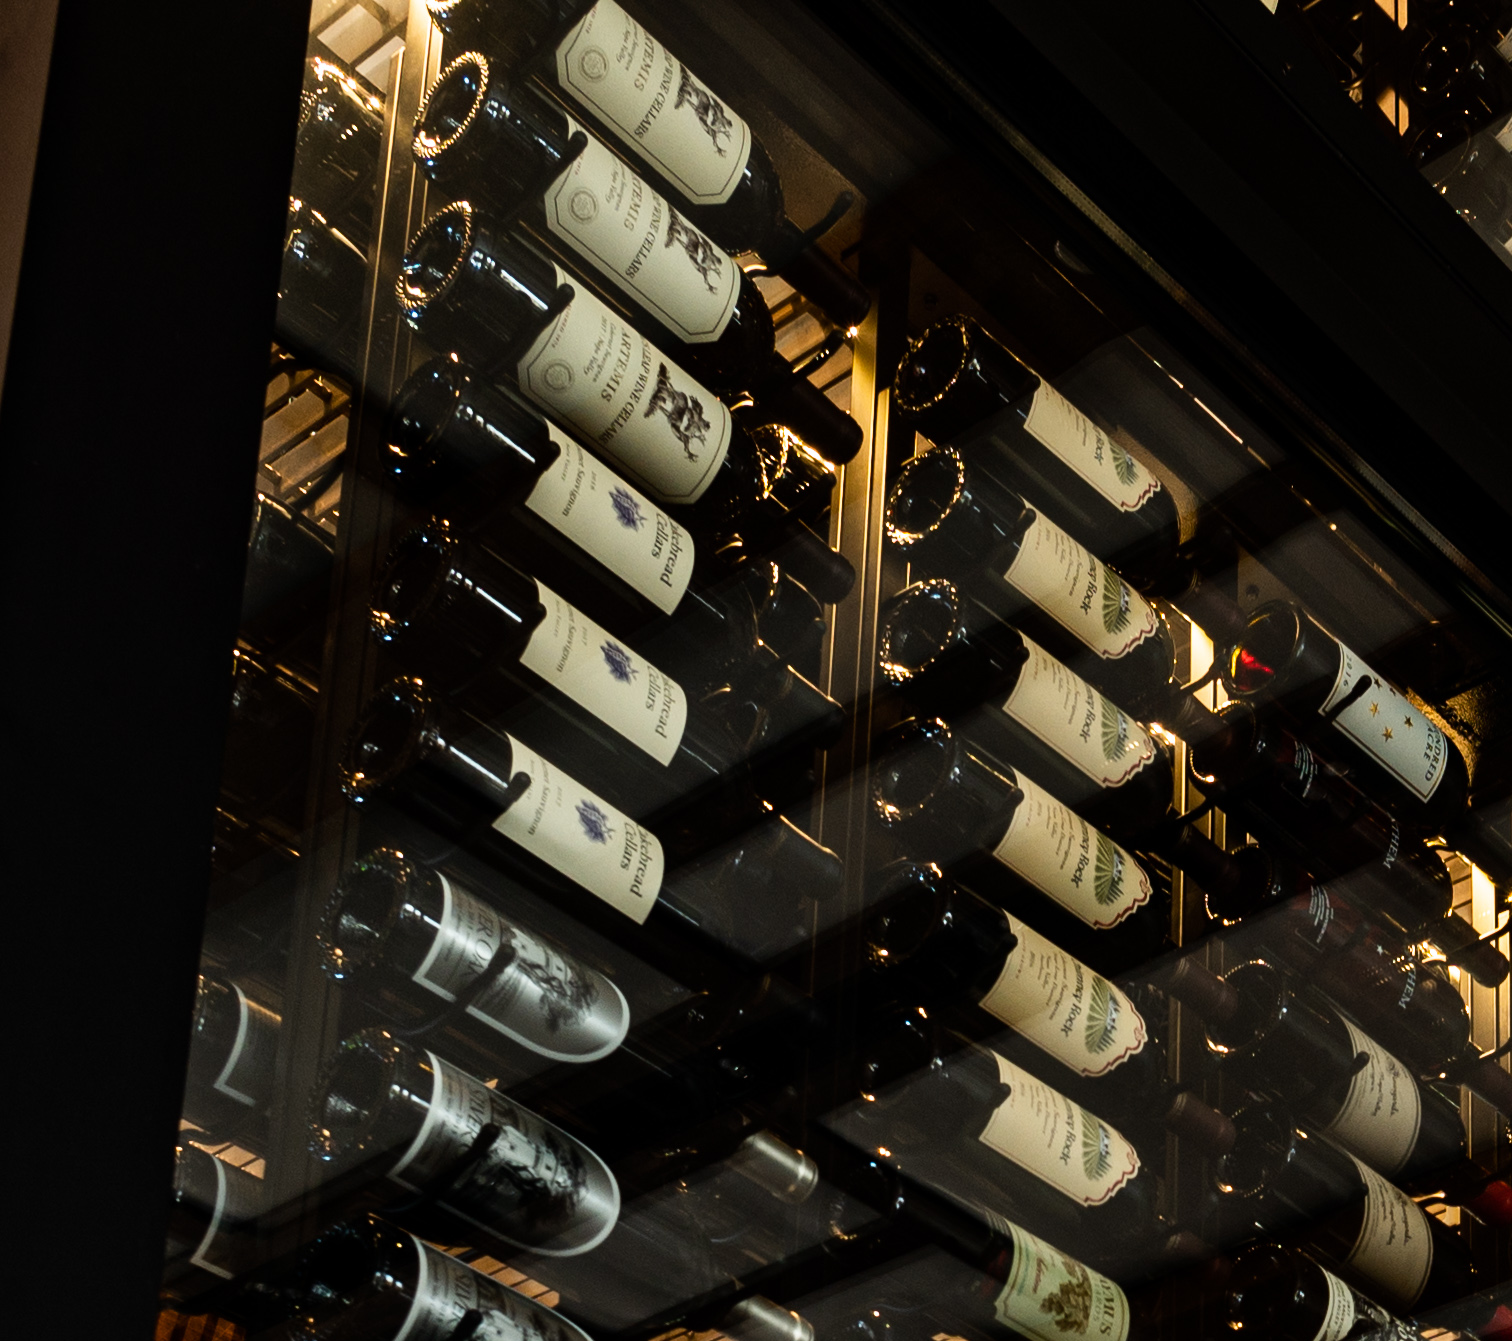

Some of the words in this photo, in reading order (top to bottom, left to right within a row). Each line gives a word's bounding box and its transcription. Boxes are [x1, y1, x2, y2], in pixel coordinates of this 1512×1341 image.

[634, 92, 665, 138] CELLARS
[625, 232, 655, 278] CELLARS
[601, 326, 632, 403] ARTEMIS
[599, 403, 635, 443] CELLARS
[651, 512, 670, 559] Cellars
[660, 514, 681, 587] akebread
[645, 664, 661, 711] Cellars
[655, 674, 676, 739] akebread
[620, 822, 638, 871] Cellars
[630, 828, 653, 897] akebread
